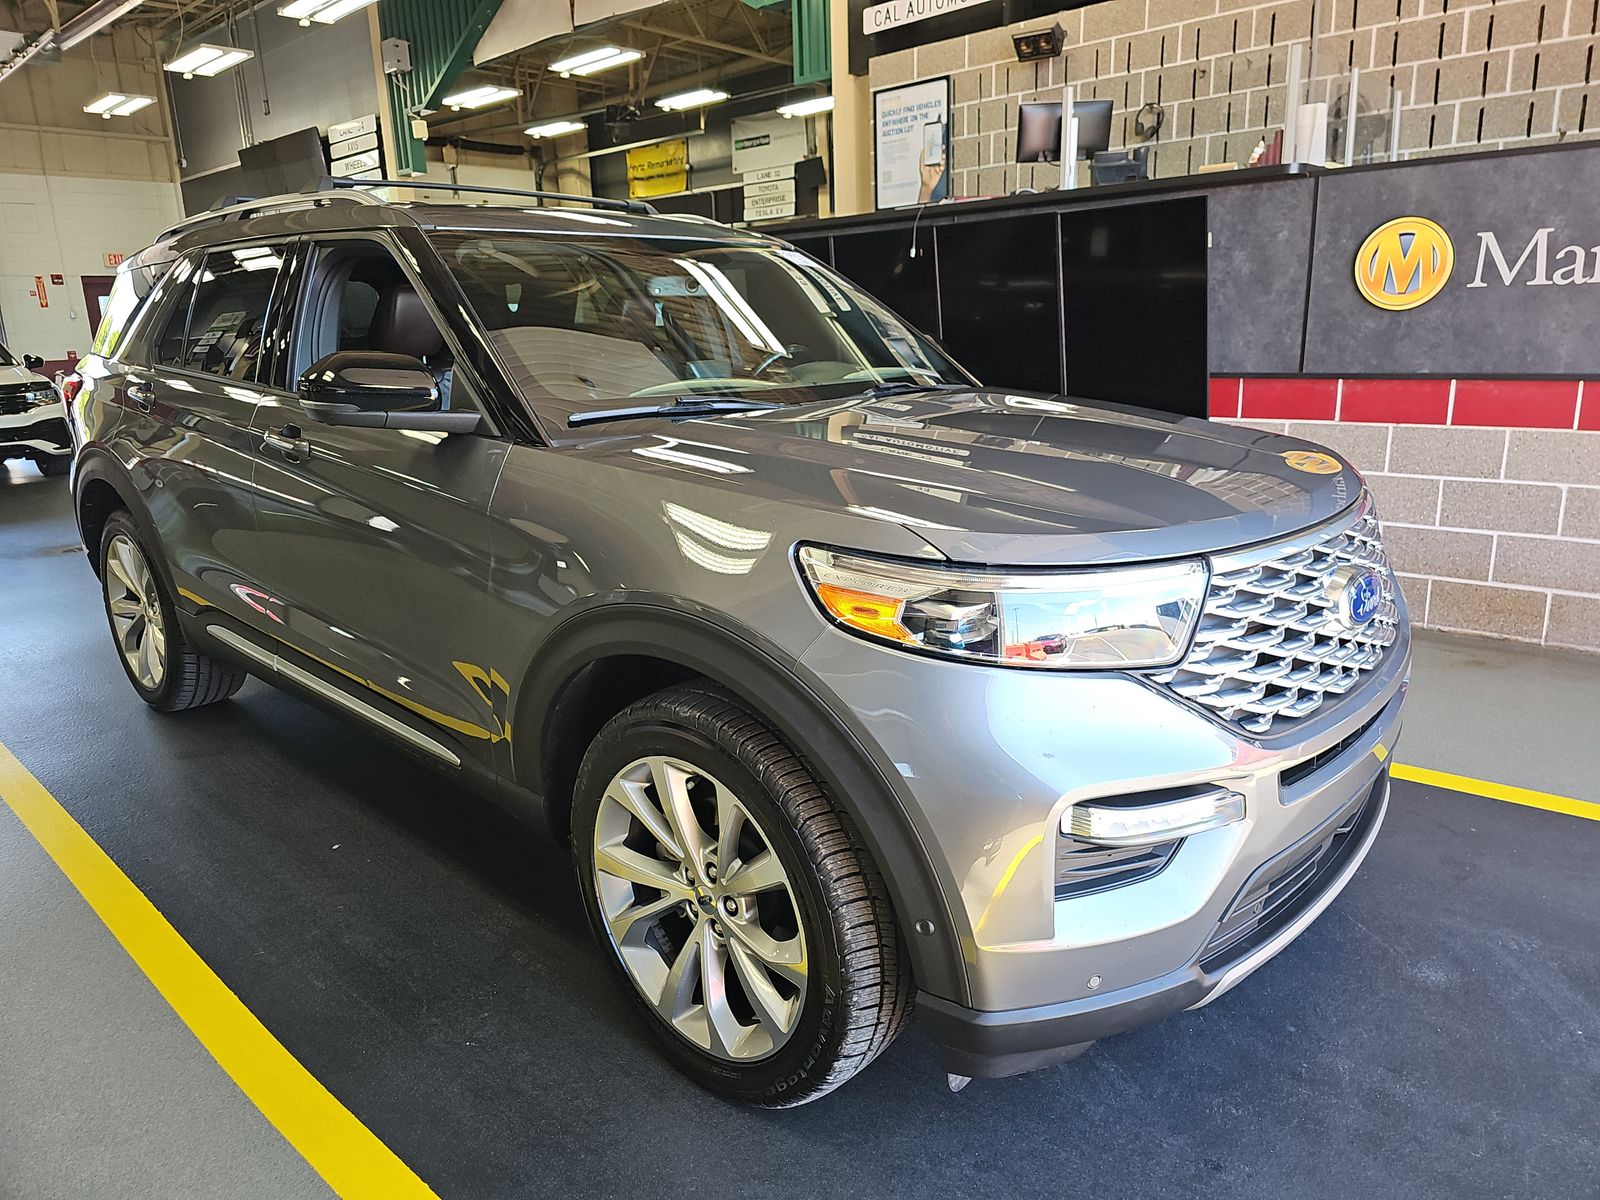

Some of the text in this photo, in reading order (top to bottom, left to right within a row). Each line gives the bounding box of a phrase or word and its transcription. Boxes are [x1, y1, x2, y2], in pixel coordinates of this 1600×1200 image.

[874, 0, 966, 27] CAL AUTO
[916, 100, 941, 110] VEHICLES
[756, 171, 771, 180] LANE
[758, 184, 779, 193] TOYOTA
[751, 194, 786, 206] ENTERPRISE
[107, 253, 124, 265] EXIT
[823, 572, 911, 593] EXPLORER
